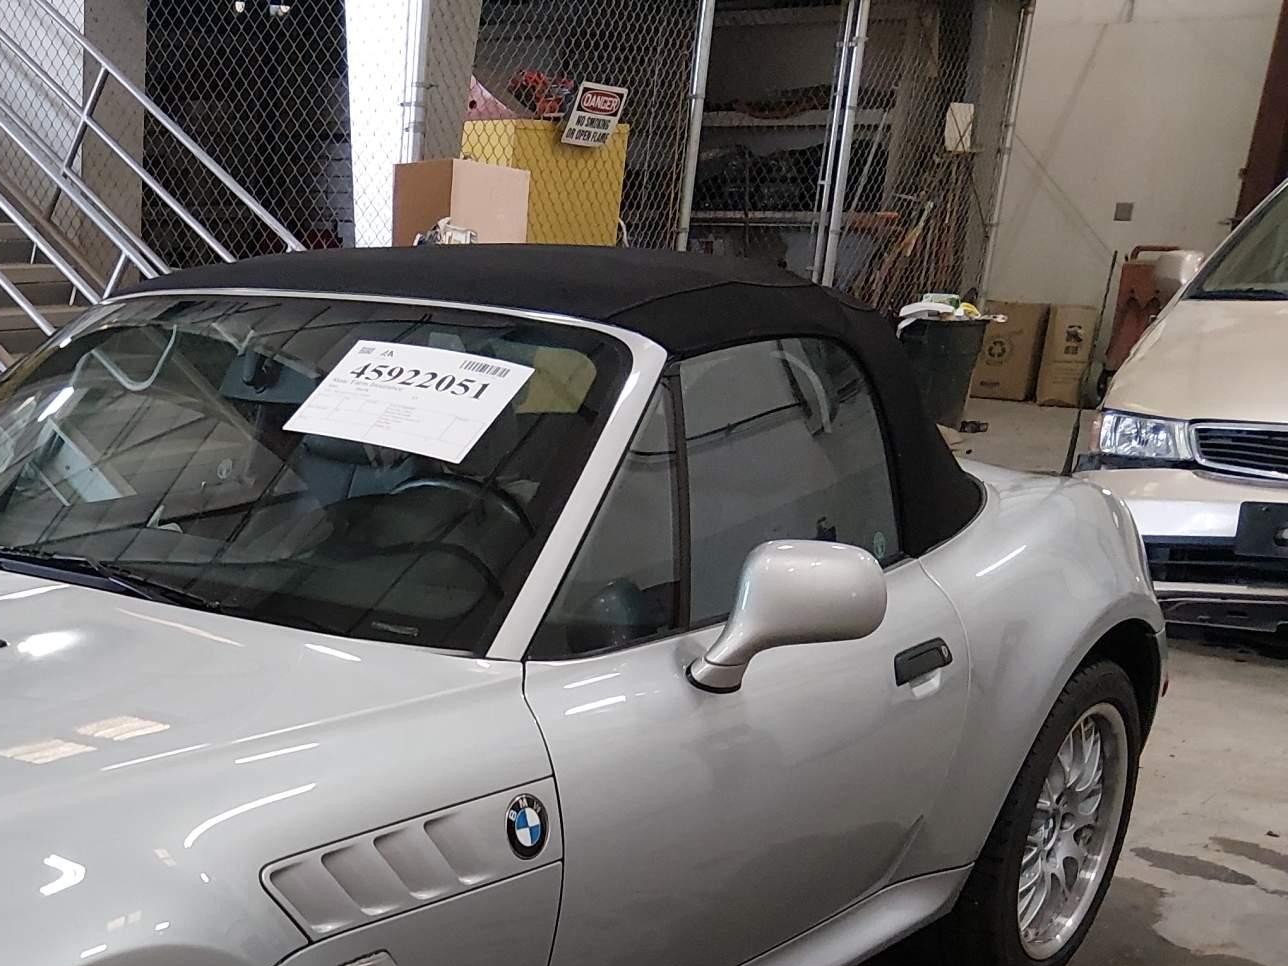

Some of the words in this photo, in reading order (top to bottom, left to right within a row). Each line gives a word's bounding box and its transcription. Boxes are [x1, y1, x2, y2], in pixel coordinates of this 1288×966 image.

[583, 93, 618, 111] DANGER
[575, 115, 585, 127] NO
[585, 116, 610, 130] SMOKING
[566, 127, 576, 139] OR
[575, 129, 592, 141] OPEN
[351, 362, 491, 400] 45922051
[508, 798, 542, 822] BMW
